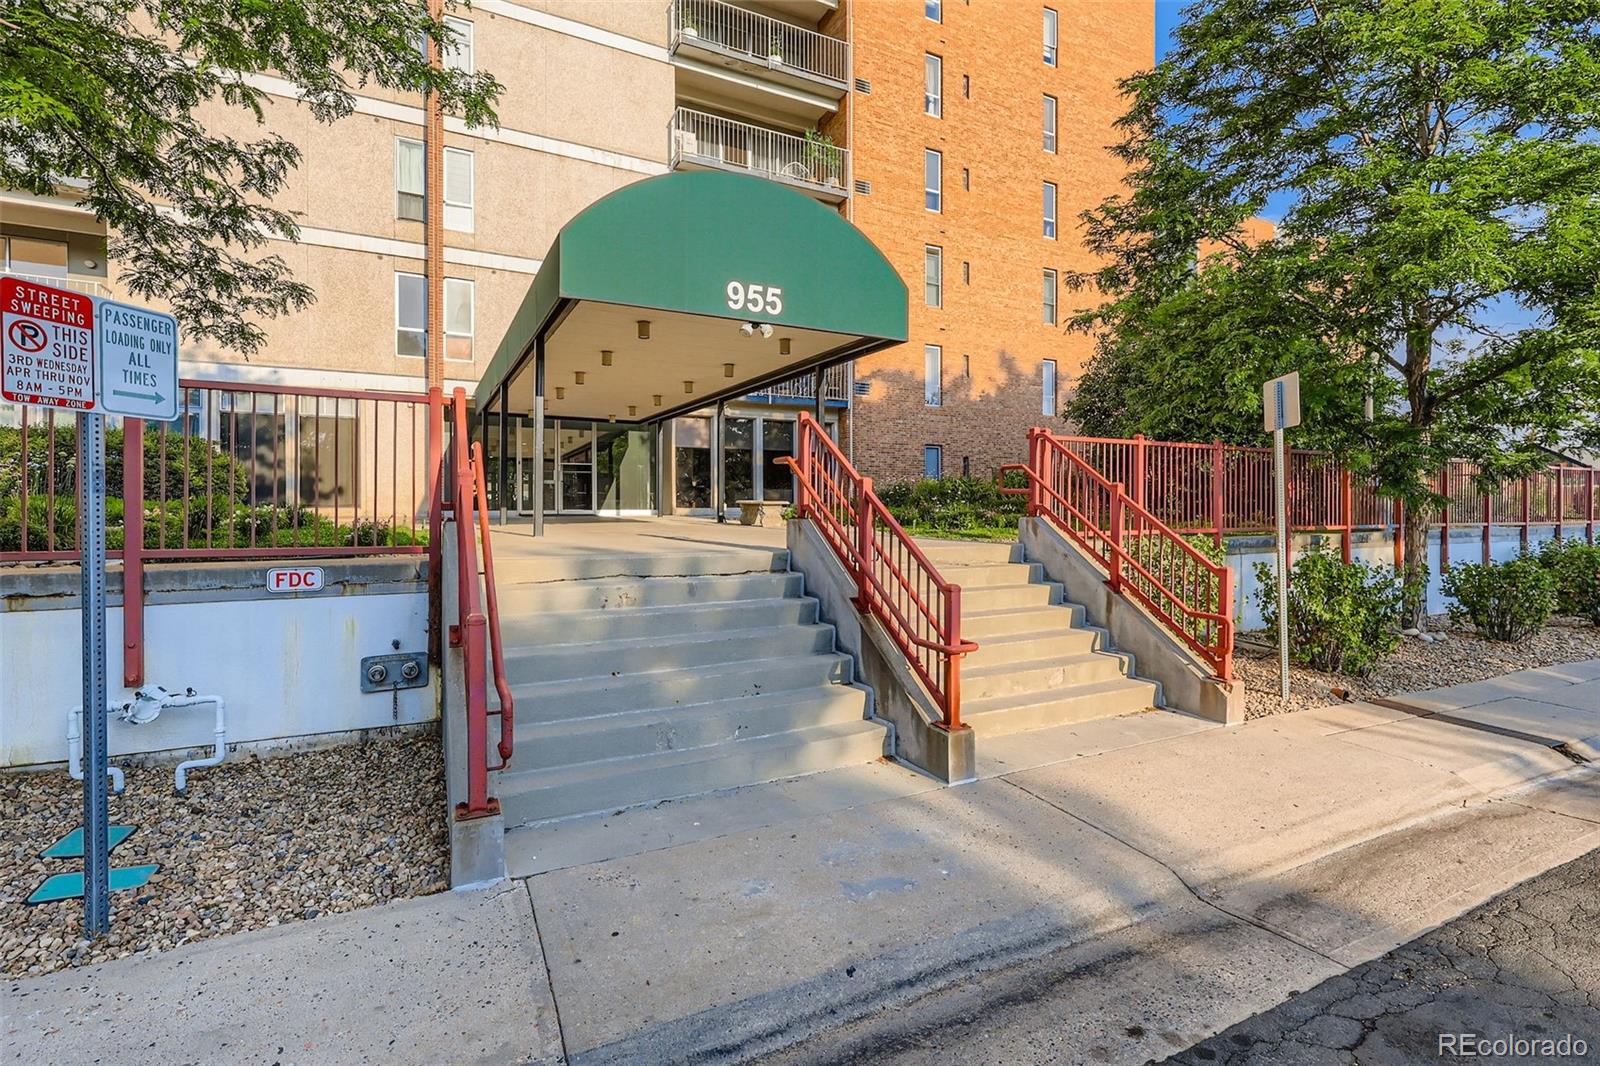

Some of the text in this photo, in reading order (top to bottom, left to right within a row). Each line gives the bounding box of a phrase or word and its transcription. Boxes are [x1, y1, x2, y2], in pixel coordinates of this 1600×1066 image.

[15, 285, 80, 311] STREET
[727, 281, 782, 315] 955
[10, 299, 85, 326] SWEEPING
[105, 308, 171, 336] PASSENGER
[52, 325, 88, 345] THIS
[105, 329, 172, 355] LOADING ONLY
[52, 342, 88, 362] SIDE
[128, 351, 151, 369] ALL
[8, 353, 87, 375] 3RD WEDNESDAY
[6, 366, 91, 386] APR THRU NOV
[122, 369, 157, 388] TIMES
[12, 393, 87, 409] TOW AWAY ZONE
[275, 571, 316, 588] FDC
